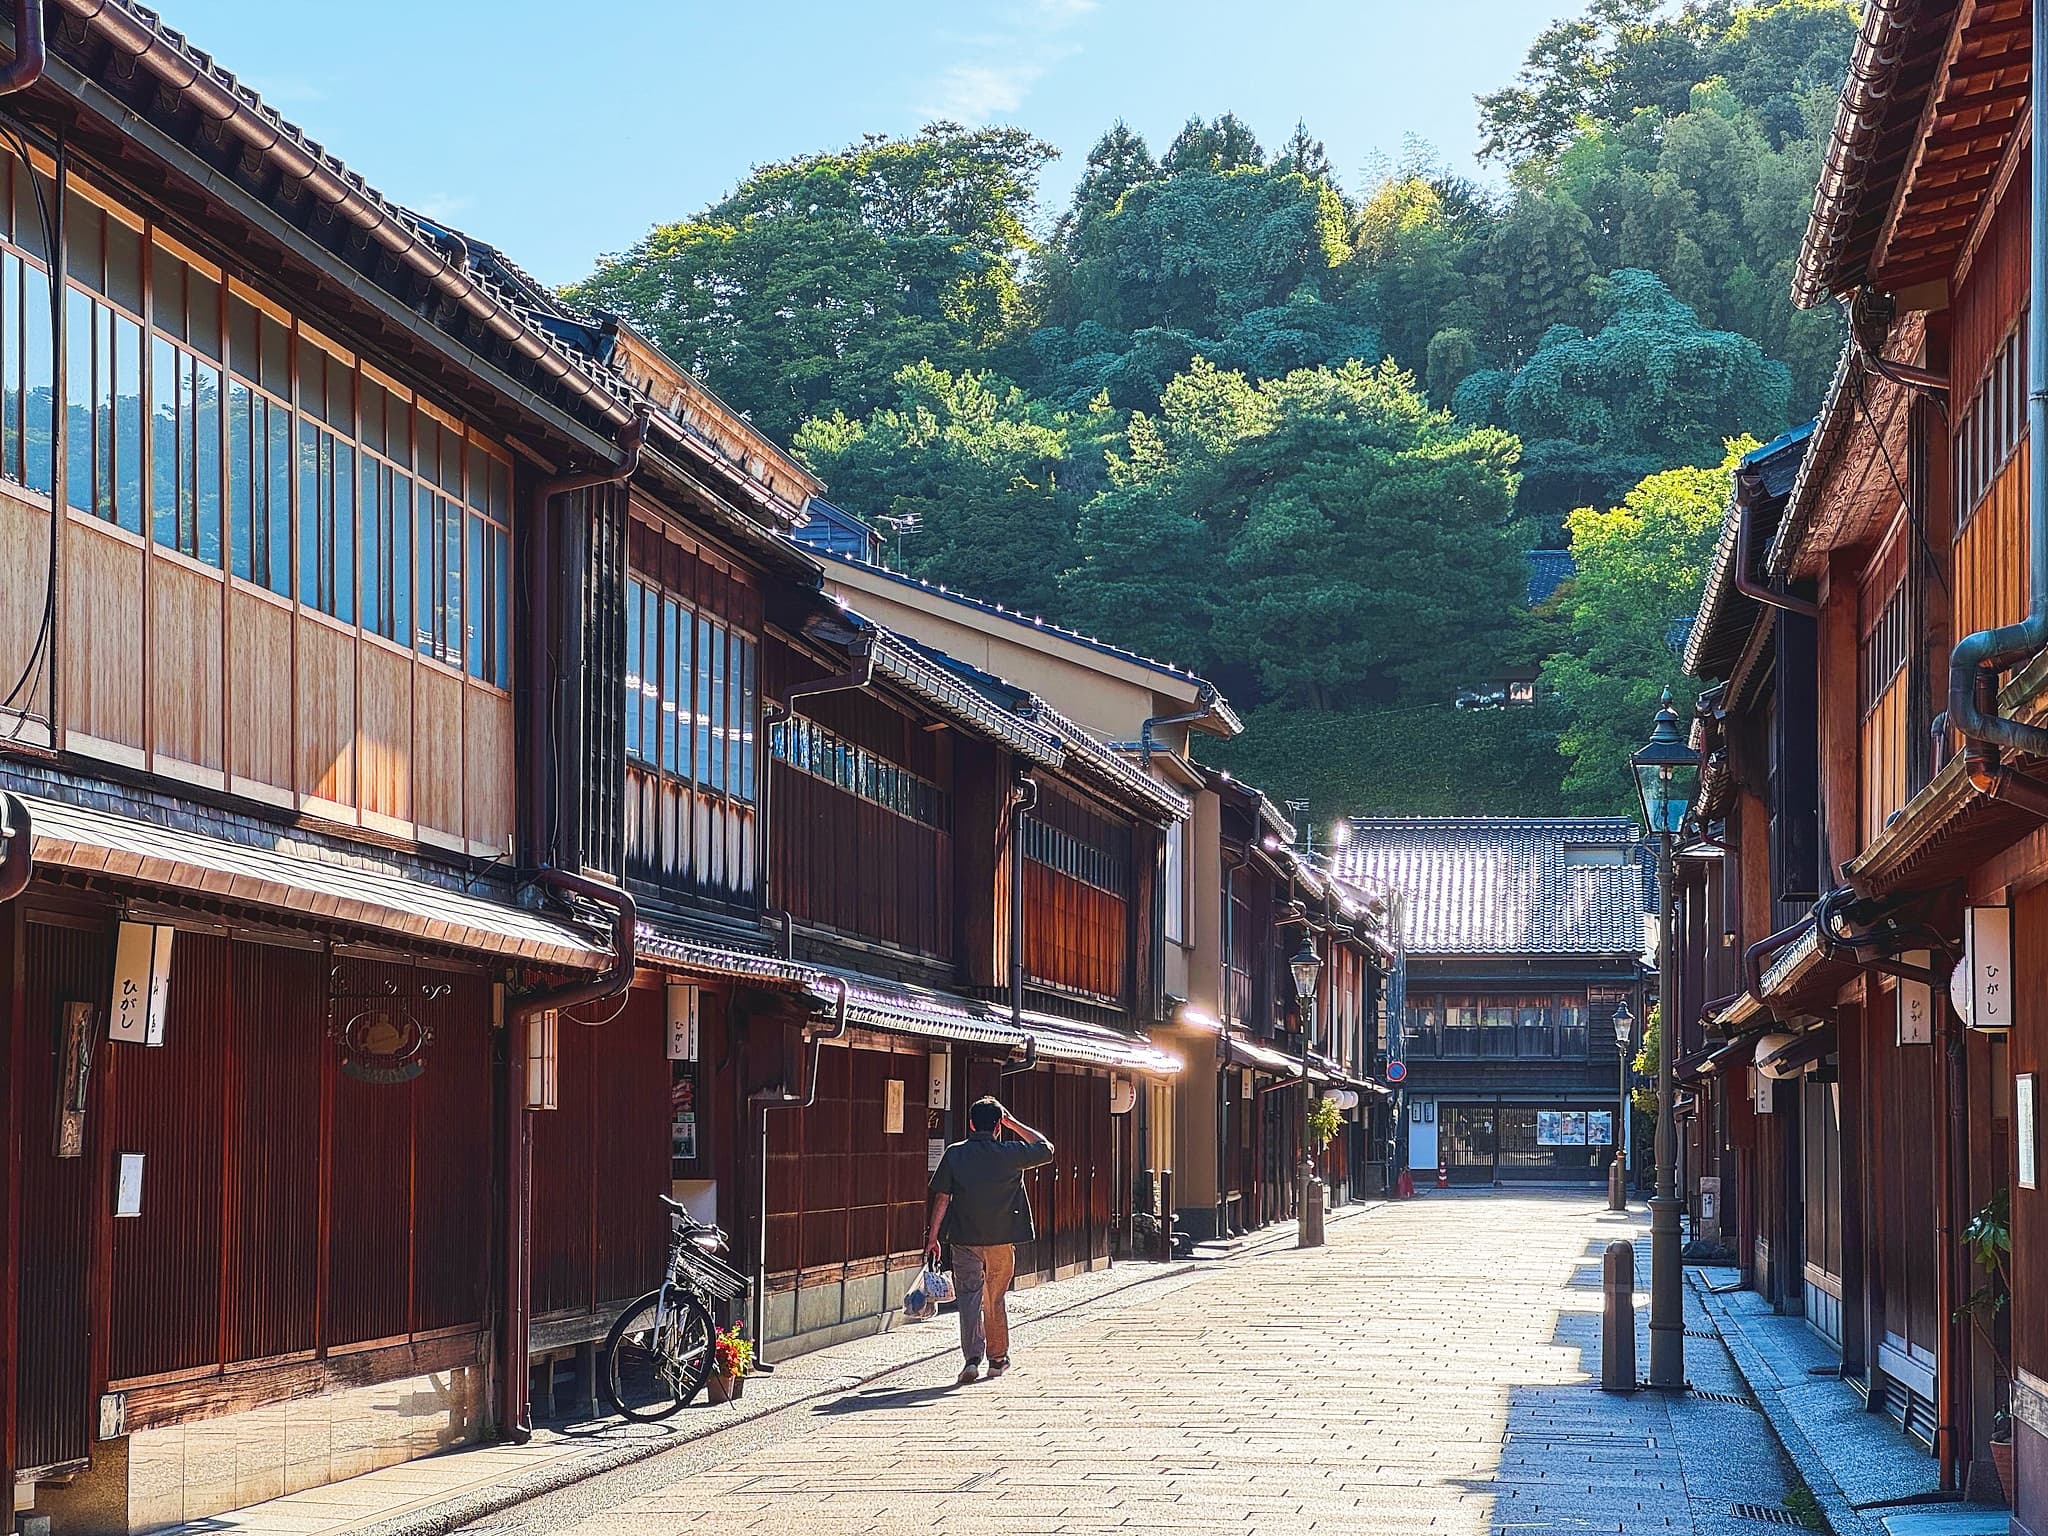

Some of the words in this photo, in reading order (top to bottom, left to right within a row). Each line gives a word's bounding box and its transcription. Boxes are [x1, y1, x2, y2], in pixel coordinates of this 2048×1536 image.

[120, 979, 138, 1029] ひがし
[1986, 965, 1999, 1014] ひがし
[674, 1021, 684, 1054] ひがし
